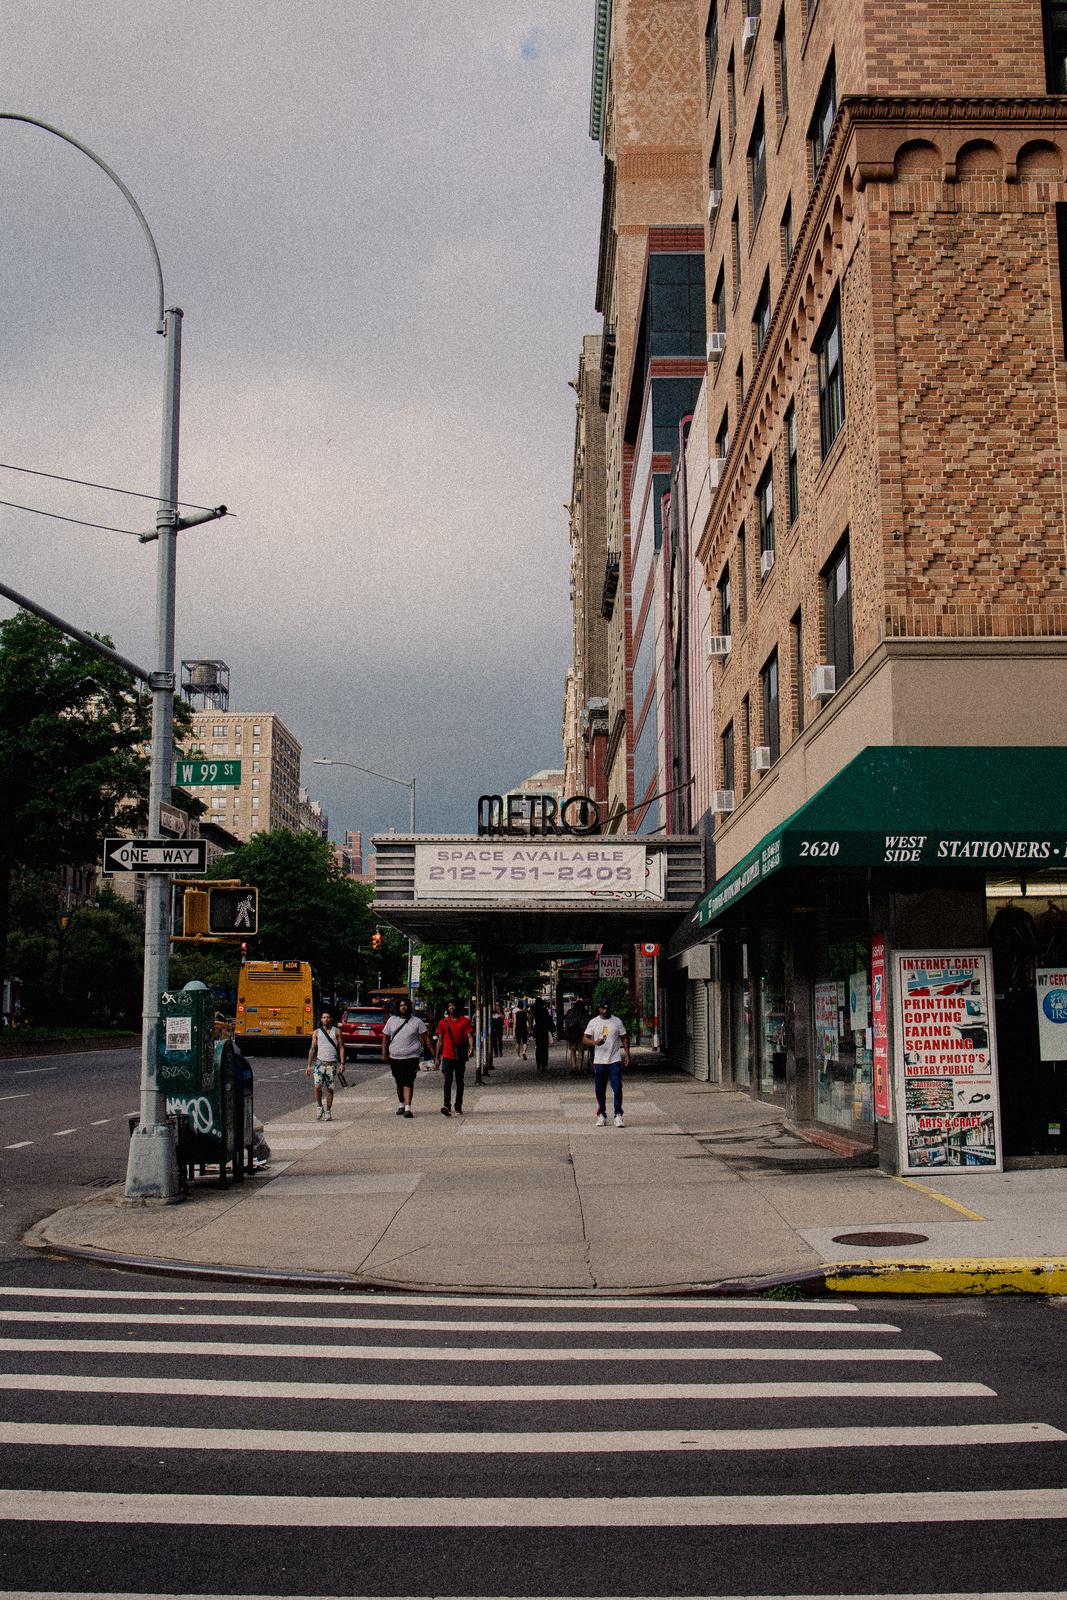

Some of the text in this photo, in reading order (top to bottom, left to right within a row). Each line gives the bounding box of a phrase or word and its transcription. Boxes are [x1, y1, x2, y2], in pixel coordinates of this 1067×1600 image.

[183, 763, 234, 783] W 99 St
[477, 795, 600, 836] METRO
[799, 841, 840, 857] 2620
[885, 836, 927, 849] WEST
[120, 849, 193, 863] ONE WAY
[437, 850, 624, 862] SPACE AVAILABLE
[884, 849, 922, 862] SIDE
[937, 840, 1051, 859] STATIONERS
[601, 959, 621, 968] NAIL
[902, 958, 951, 971] INTERNET
[605, 969, 622, 977] SPA
[1037, 974, 1048, 986] W7
[903, 998, 966, 1010] PRINTING
[904, 1011, 962, 1024] COPYING
[905, 1025, 951, 1037] FAXING
[906, 1038, 973, 1051] SCANNING
[924, 1053, 985, 1064] ID PHOTO'S
[907, 1065, 974, 1076] NOTARY PUBLIC
[919, 1117, 981, 1129] ARTS & CRAFT
